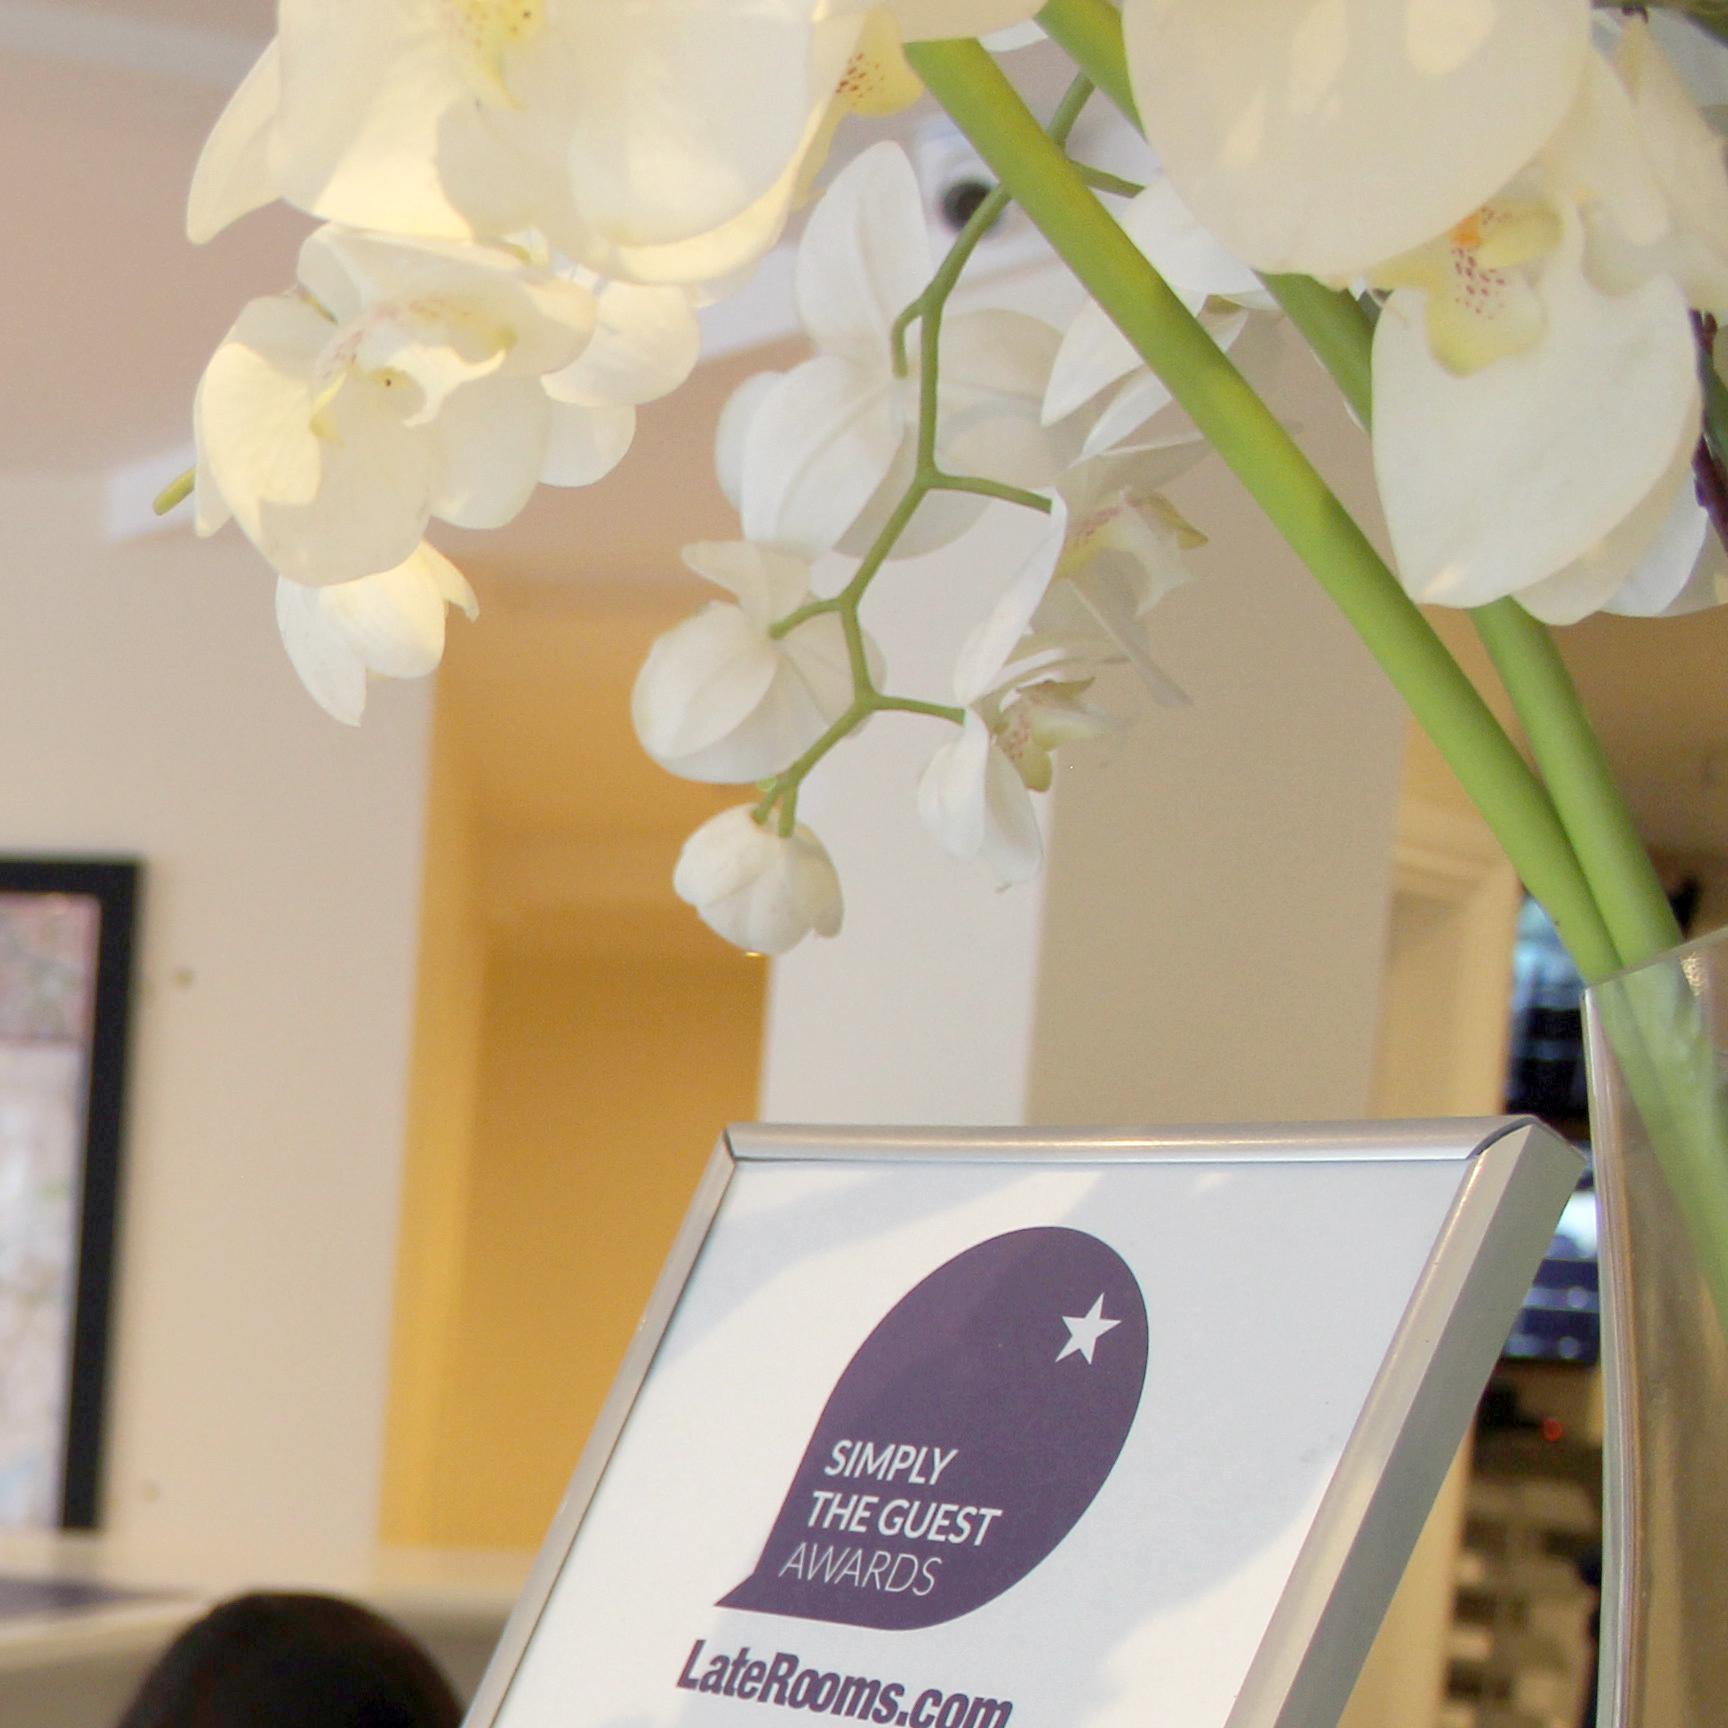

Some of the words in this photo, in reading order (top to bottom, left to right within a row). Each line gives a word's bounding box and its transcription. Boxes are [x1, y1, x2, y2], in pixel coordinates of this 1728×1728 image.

[824, 1440, 958, 1485] SIMPLY
[808, 1491, 878, 1533] THE
[878, 1499, 1002, 1545] GUEST
[778, 1542, 942, 1596] AWARDS
